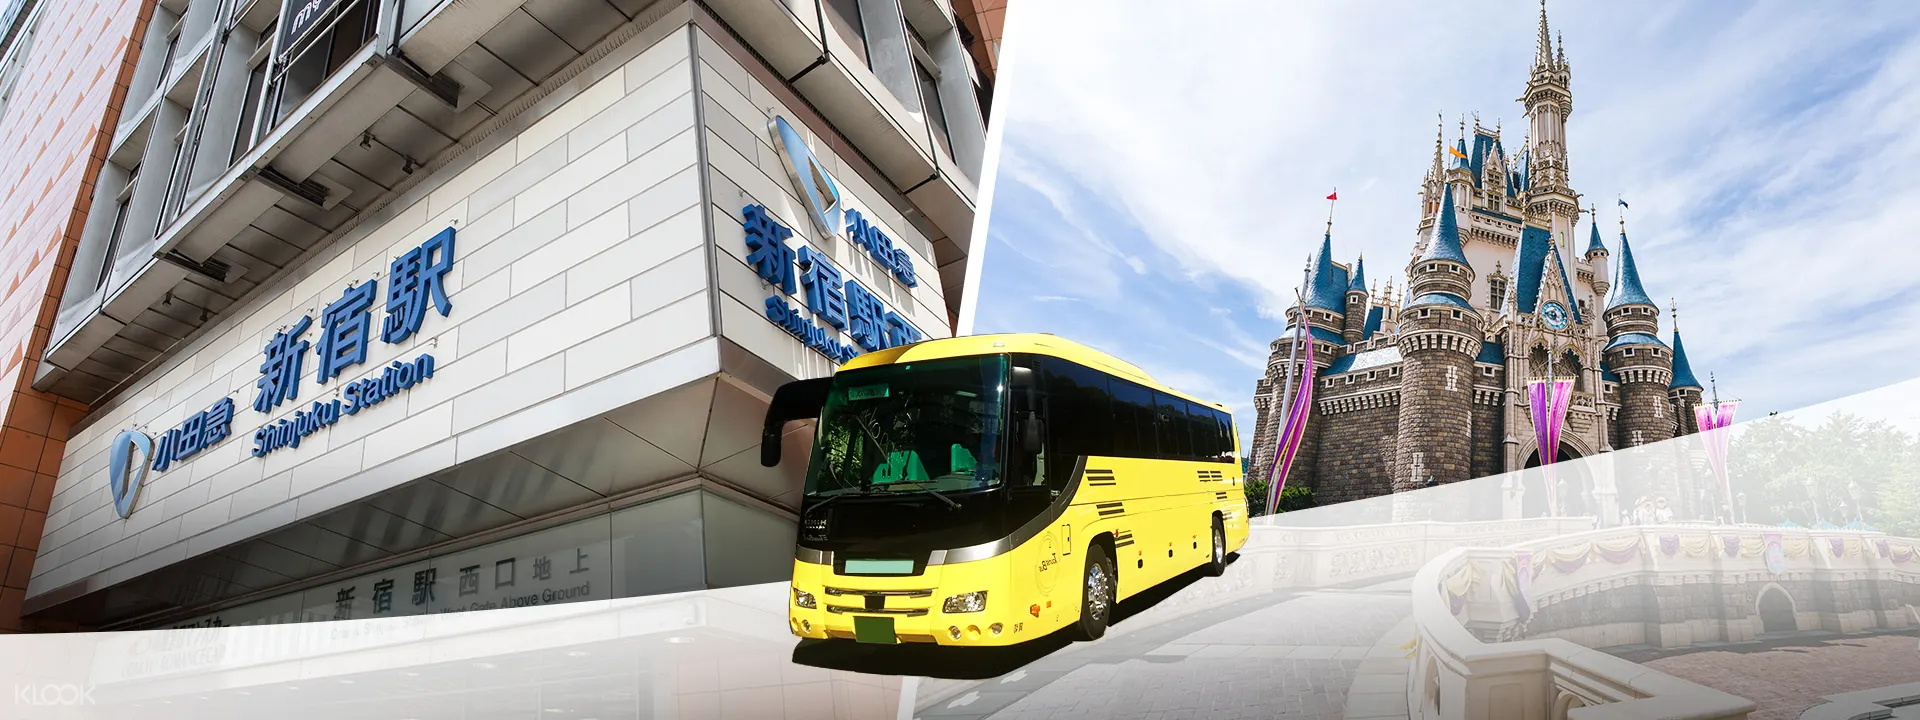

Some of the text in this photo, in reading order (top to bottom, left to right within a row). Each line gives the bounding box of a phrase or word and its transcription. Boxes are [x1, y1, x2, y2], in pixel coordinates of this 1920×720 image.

[845, 207, 918, 288] 小田急
[253, 226, 456, 414] 新宿駅
[765, 295, 842, 361] Shinjuku
[152, 396, 236, 472] 小田急
[251, 353, 435, 458] Shinjuku Station
[500, 593, 538, 609] Above
[542, 581, 591, 603] Ground
